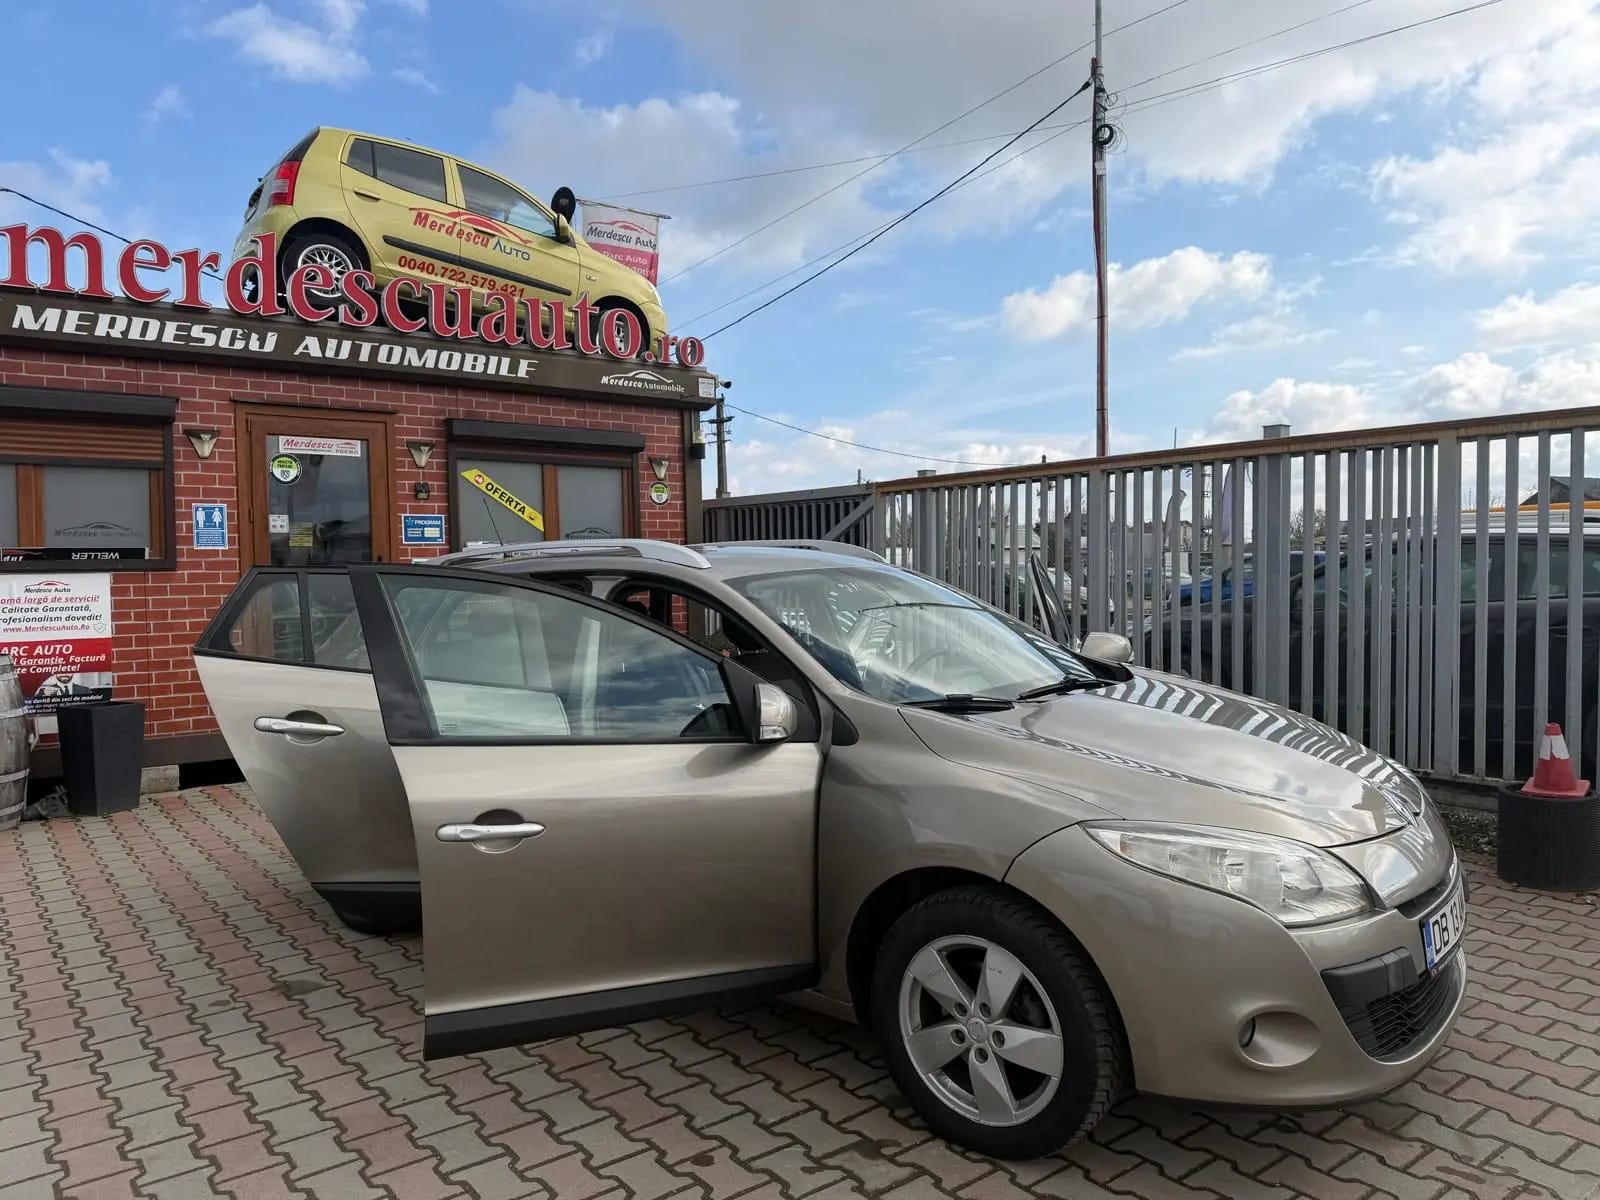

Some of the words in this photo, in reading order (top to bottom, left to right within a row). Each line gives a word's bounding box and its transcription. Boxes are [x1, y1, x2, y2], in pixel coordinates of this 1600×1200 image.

[413, 211, 490, 248] Merdescu
[493, 237, 530, 261] AUTO
[587, 225, 632, 243] Merdescu
[625, 255, 648, 265] Auto
[398, 255, 525, 298] 0040.722.579.421
[12, 304, 278, 352] MERDESCU
[293, 336, 538, 379] AUTOMOBILE
[283, 439, 334, 449] Merdescu
[485, 481, 527, 516] OFERTA
[71, 552, 120, 560] WELLER
[51, 595, 62, 603] de
[65, 595, 100, 603] servicii!
[2, 606, 40, 614] Calitate
[42, 604, 92, 613] Garantată,
[65, 613, 102, 621] dovedit!
[3, 624, 90, 633] www.MerdescuAuto.Ro
[33, 644, 73, 655] AUTO
[69, 654, 106, 663] Factură
[30, 664, 80, 674] Complete!
[1431, 912, 1449, 955] DB
